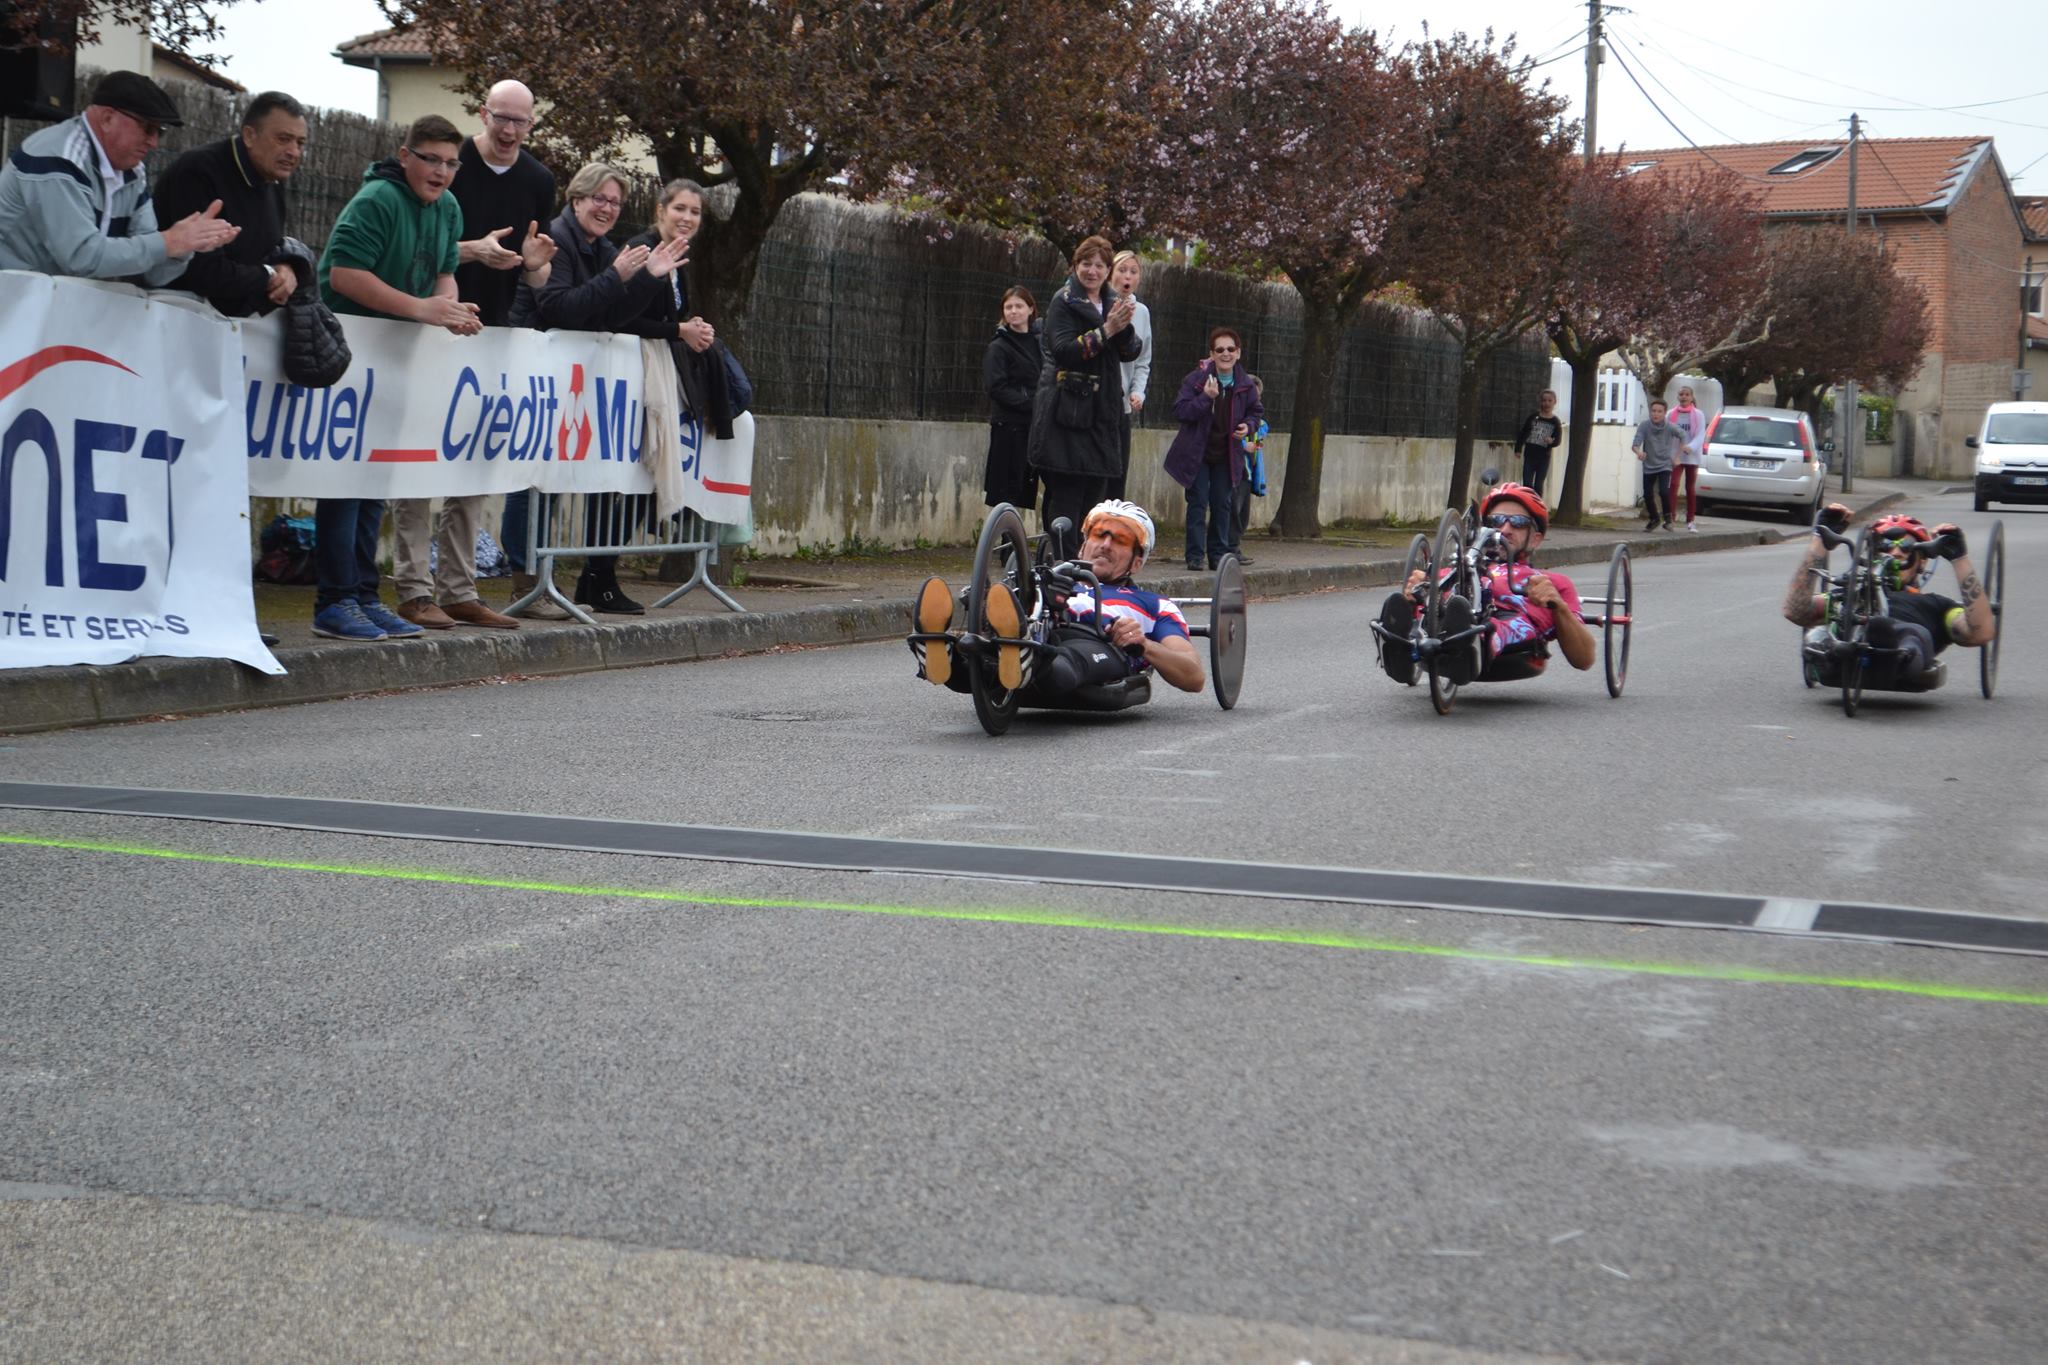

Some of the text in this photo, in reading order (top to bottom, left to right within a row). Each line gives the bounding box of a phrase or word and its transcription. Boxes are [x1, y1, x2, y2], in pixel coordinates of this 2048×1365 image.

[243, 355, 703, 480] utuel Crédit Muel
[42, 613, 77, 639] ET
